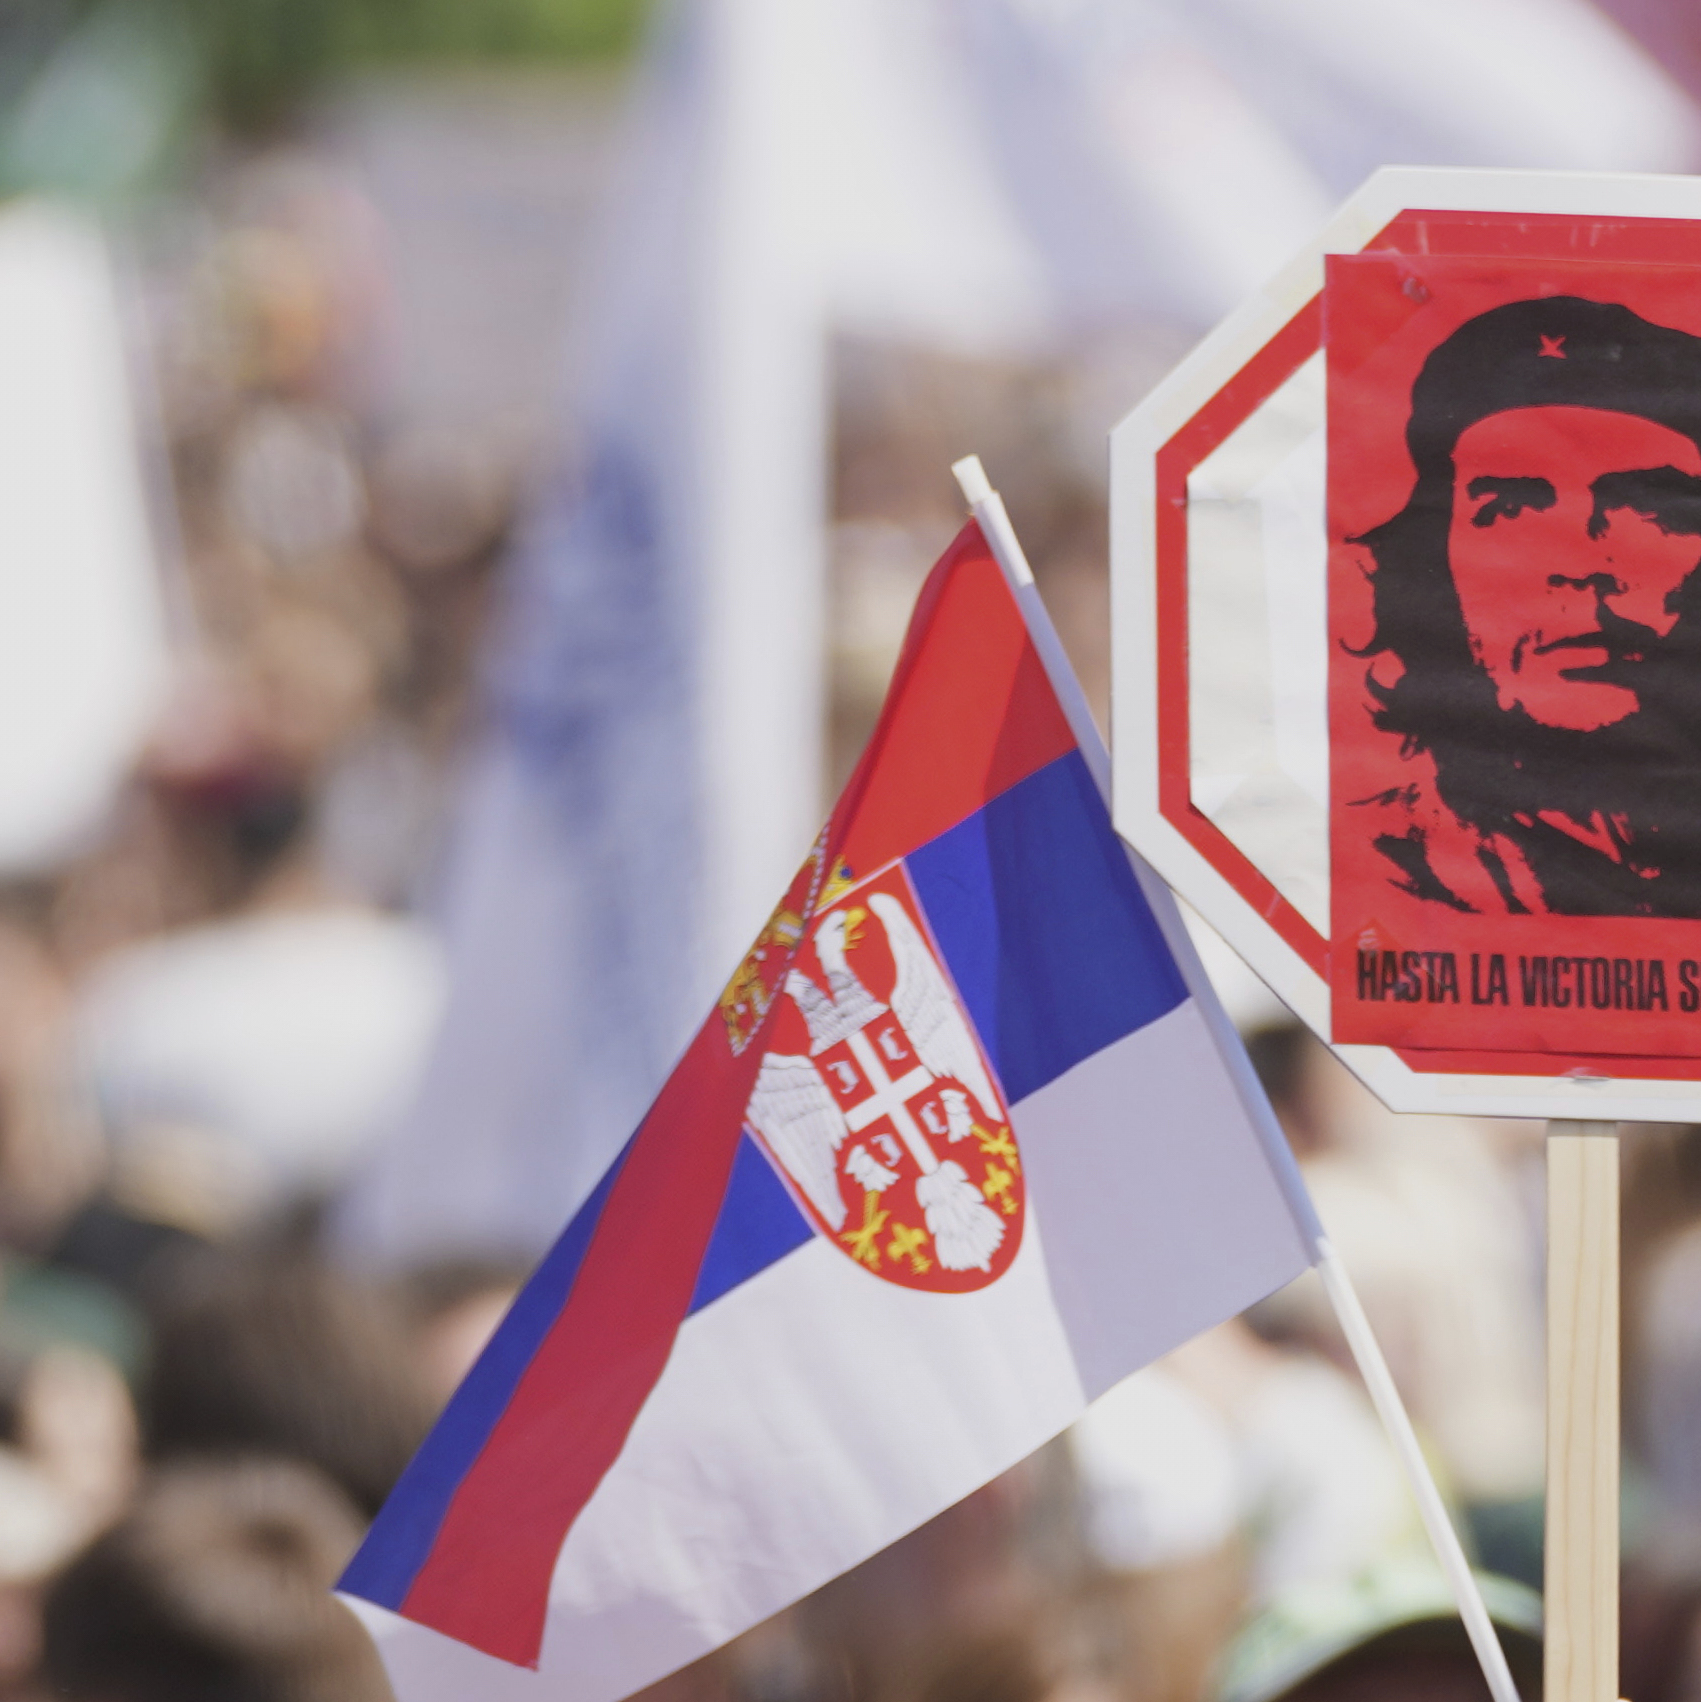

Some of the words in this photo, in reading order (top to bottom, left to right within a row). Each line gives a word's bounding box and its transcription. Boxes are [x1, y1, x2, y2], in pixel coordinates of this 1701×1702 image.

[1356, 948, 1461, 1004] HASTA
[1469, 953, 1510, 1006] LA
[1518, 956, 1669, 1012] VICTORIA
